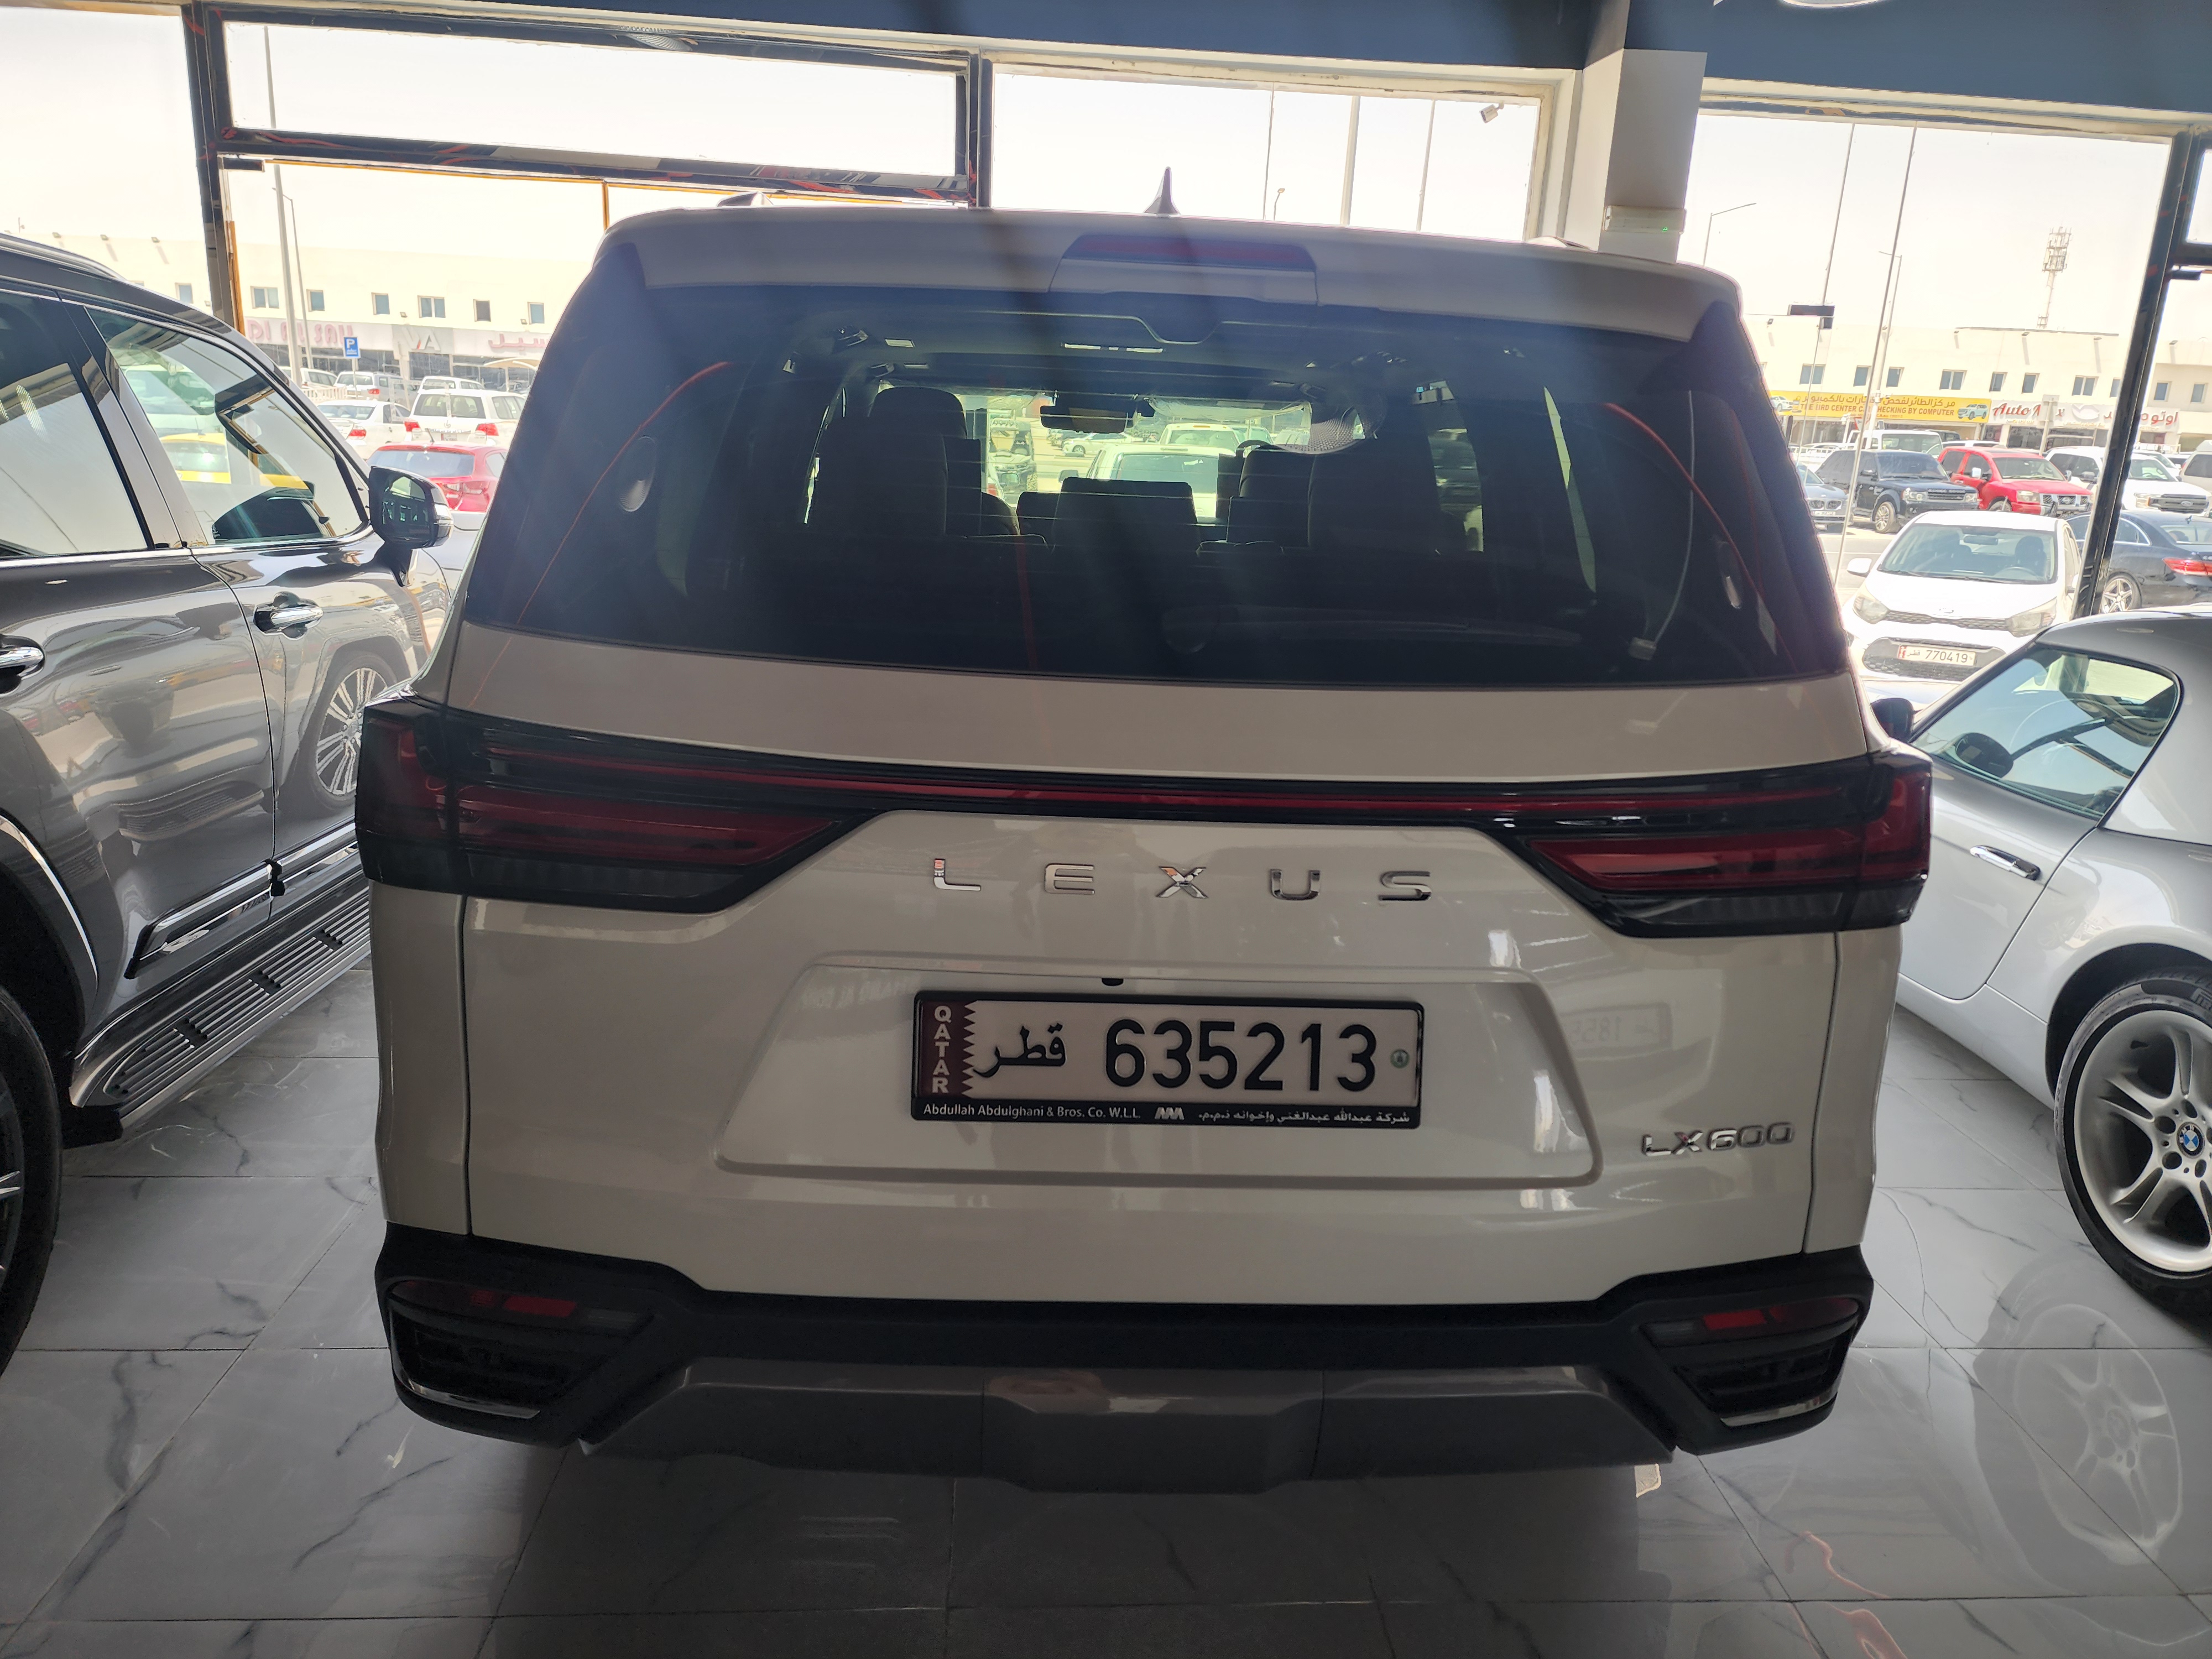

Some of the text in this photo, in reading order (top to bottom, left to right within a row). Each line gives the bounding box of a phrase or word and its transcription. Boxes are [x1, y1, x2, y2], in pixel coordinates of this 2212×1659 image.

[247, 319, 270, 341] DI
[346, 338, 356, 349] P
[1992, 403, 2031, 416] Auto
[1925, 649, 1968, 663] 770419
[933, 858, 1431, 902] LEXUS
[932, 1005, 952, 1094] QATAR
[973, 1022, 1066, 1078] قطر
[1106, 1019, 1377, 1092] 635213
[923, 1104, 974, 1117] Abdullah
[978, 1105, 1044, 1119] Abdulghani
[1046, 1106, 1055, 1117] &
[1057, 1107, 1086, 1118] Bros.
[1087, 1107, 1106, 1118] Co.
[1376, 1111, 1410, 1124] شركة
